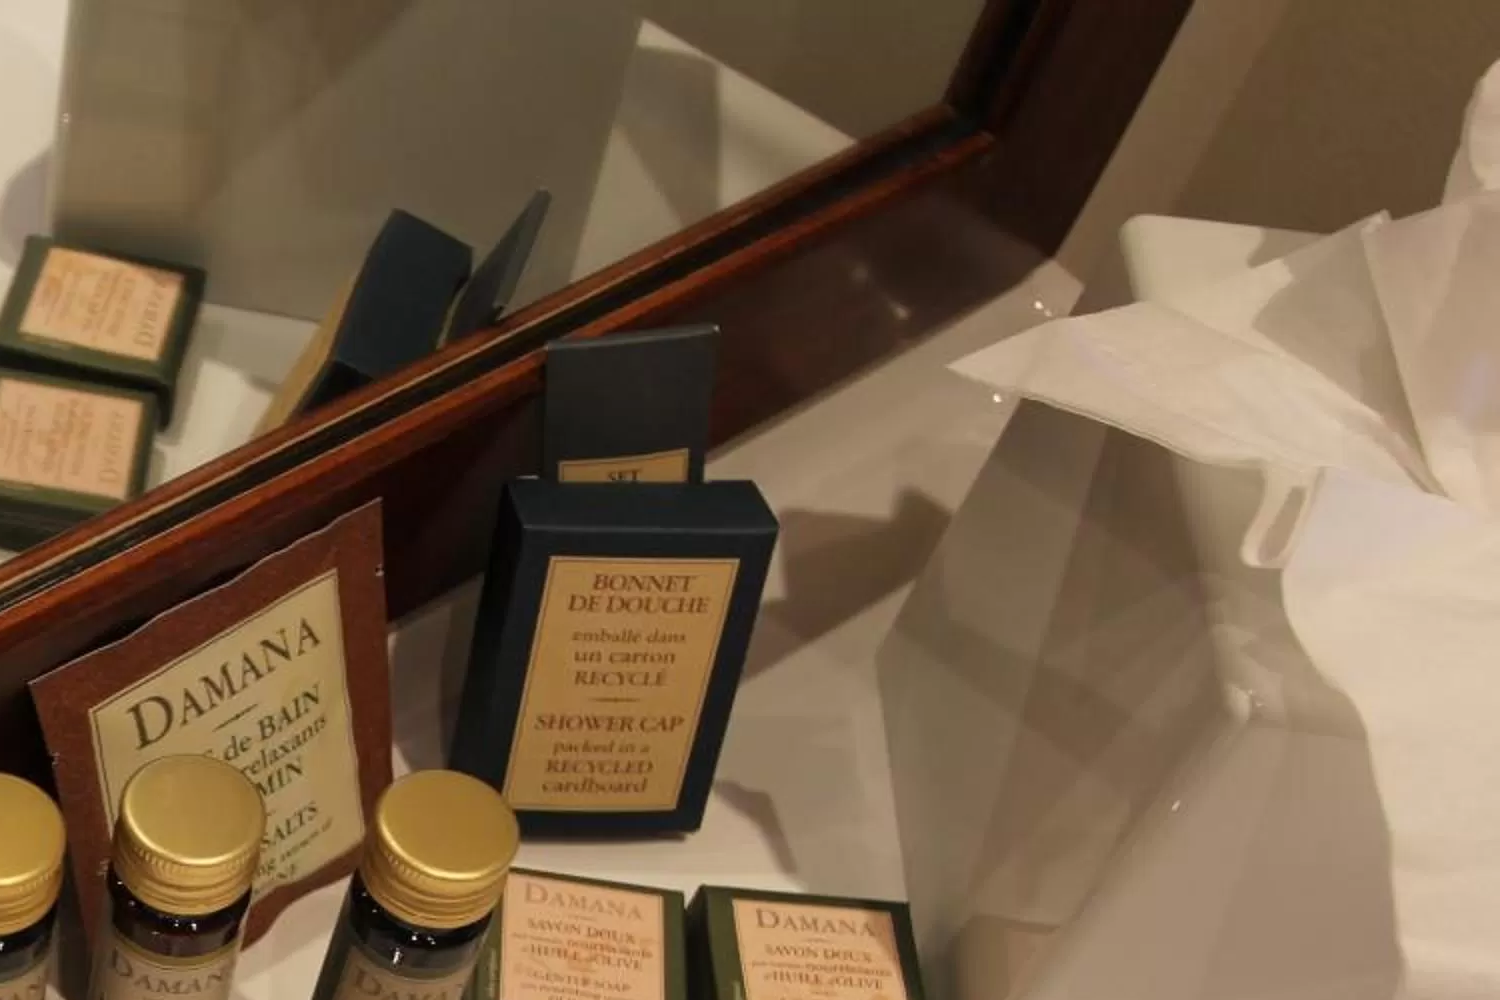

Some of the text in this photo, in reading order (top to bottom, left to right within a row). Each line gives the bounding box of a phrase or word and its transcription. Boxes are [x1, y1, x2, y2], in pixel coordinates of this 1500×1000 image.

[593, 573, 696, 593] BONNET
[568, 594, 710, 613] DE DOUCHE
[646, 628, 686, 644] dans
[574, 651, 676, 665] un carton
[127, 617, 321, 750] DAMANA
[224, 681, 321, 761] de BAIN
[534, 713, 685, 733] SHOWER CAP
[552, 739, 615, 756] packed
[546, 759, 654, 774] RECYCLED
[541, 777, 648, 793] cardboard
[524, 882, 643, 921] DAMANA
[756, 908, 876, 937] DAMANA
